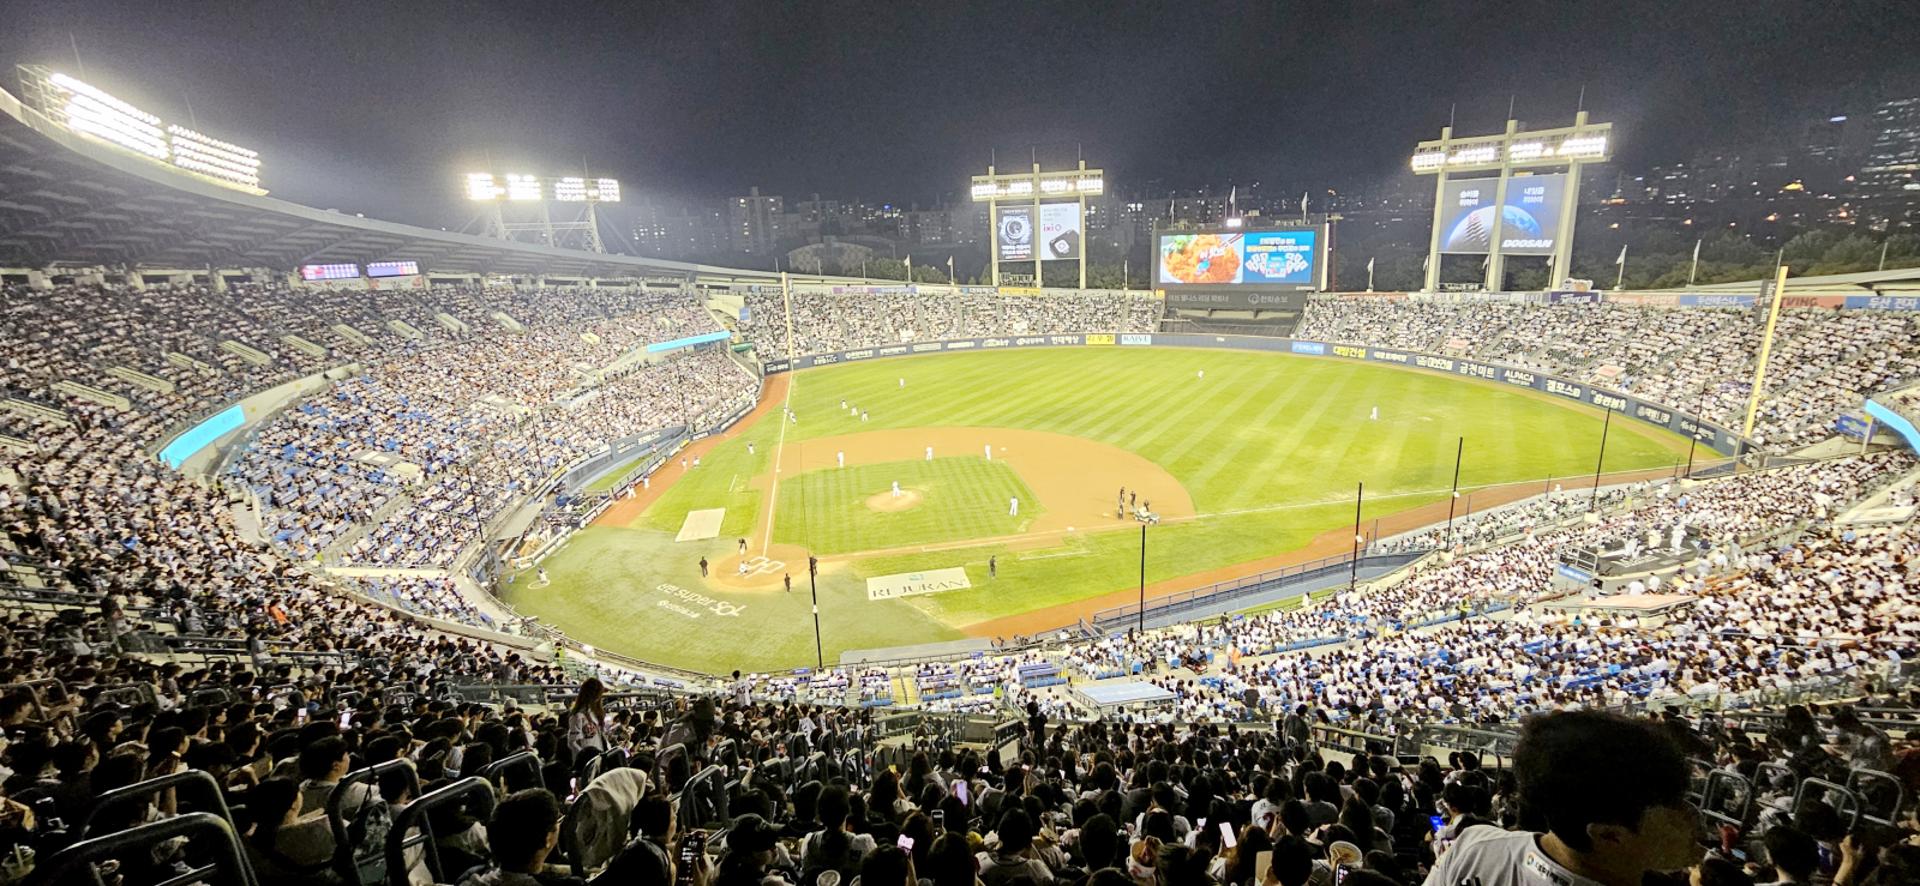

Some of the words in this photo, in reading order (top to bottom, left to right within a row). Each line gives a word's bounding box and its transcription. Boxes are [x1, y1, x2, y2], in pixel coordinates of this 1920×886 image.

[1502, 239, 1553, 248] DOOSAN
[1459, 362, 1495, 378] 금천미트
[1504, 370, 1535, 383] ALPACA
